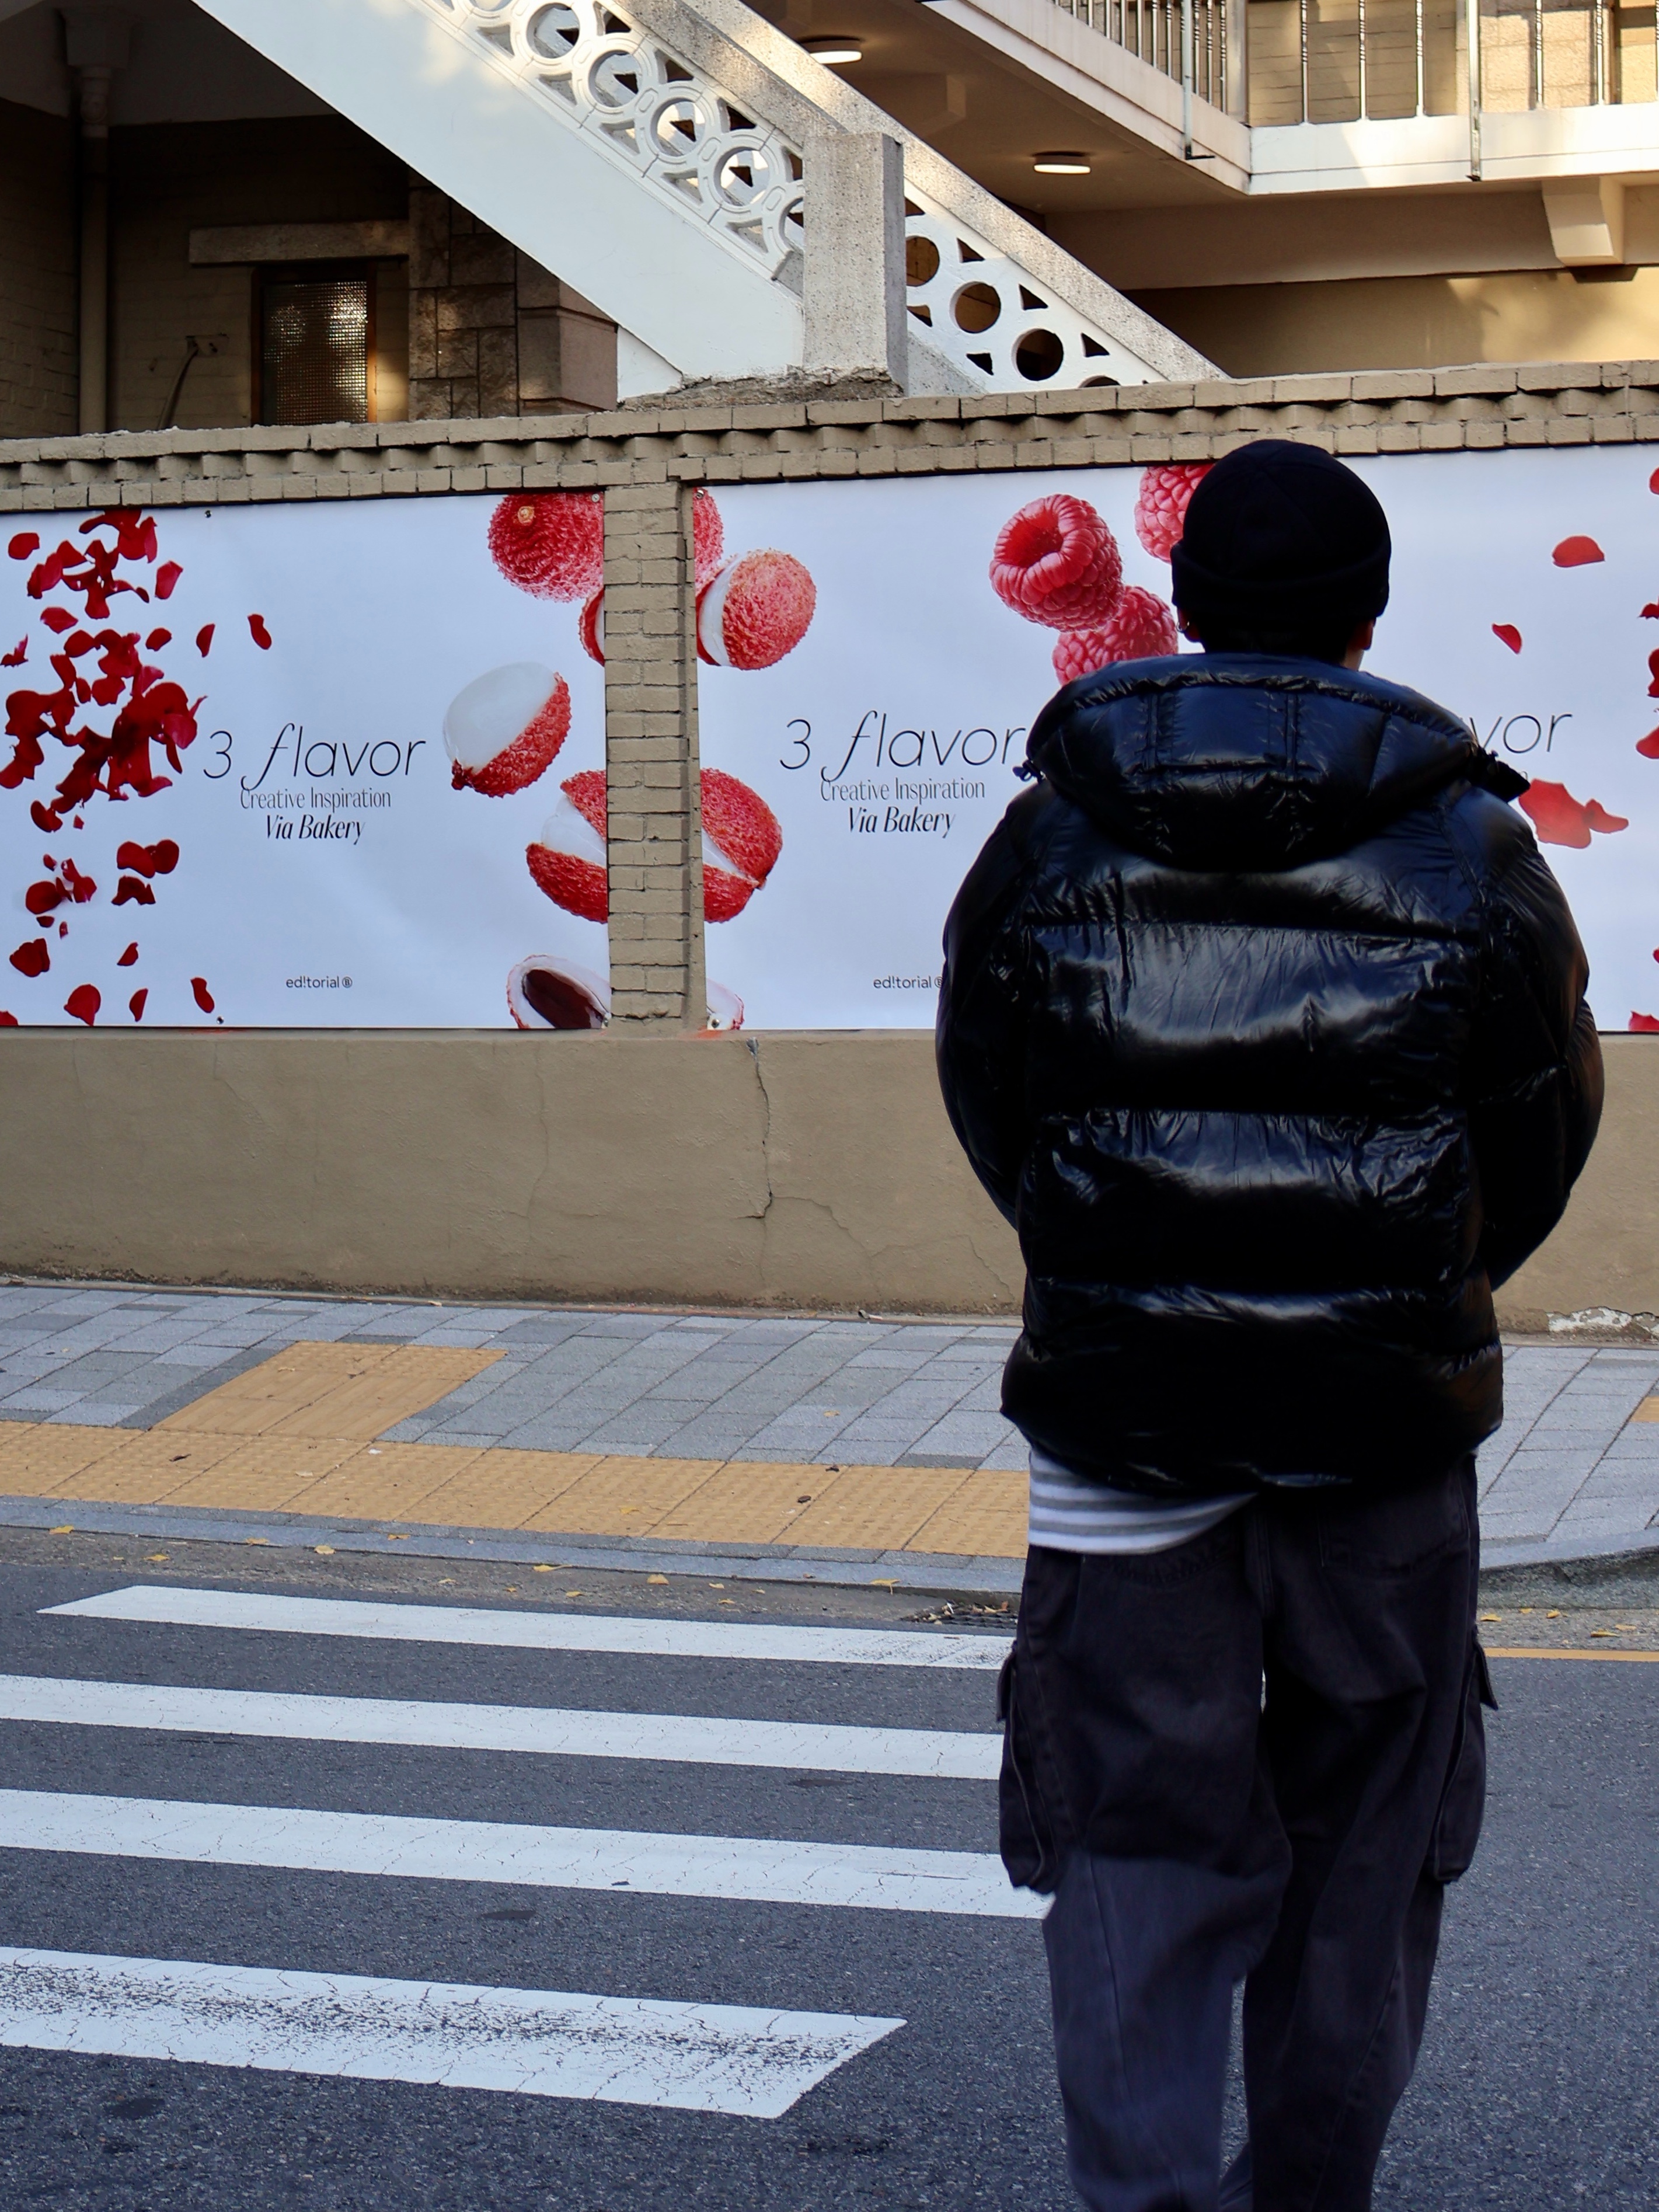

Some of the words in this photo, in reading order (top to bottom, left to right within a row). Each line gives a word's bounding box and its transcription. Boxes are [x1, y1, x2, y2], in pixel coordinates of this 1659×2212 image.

[779, 719, 811, 769] 3
[820, 710, 1026, 782] flavor
[1468, 713, 1573, 754] vor
[203, 730, 232, 779] 3
[240, 723, 427, 790] flavor
[240, 788, 305, 809] Creative
[311, 786, 391, 813] Inspiration
[820, 779, 890, 801] Creative
[895, 776, 985, 805] Inspiration
[266, 814, 294, 839] Via
[298, 814, 365, 845] Bakery
[849, 806, 878, 833] Via
[883, 806, 956, 839] Bakery
